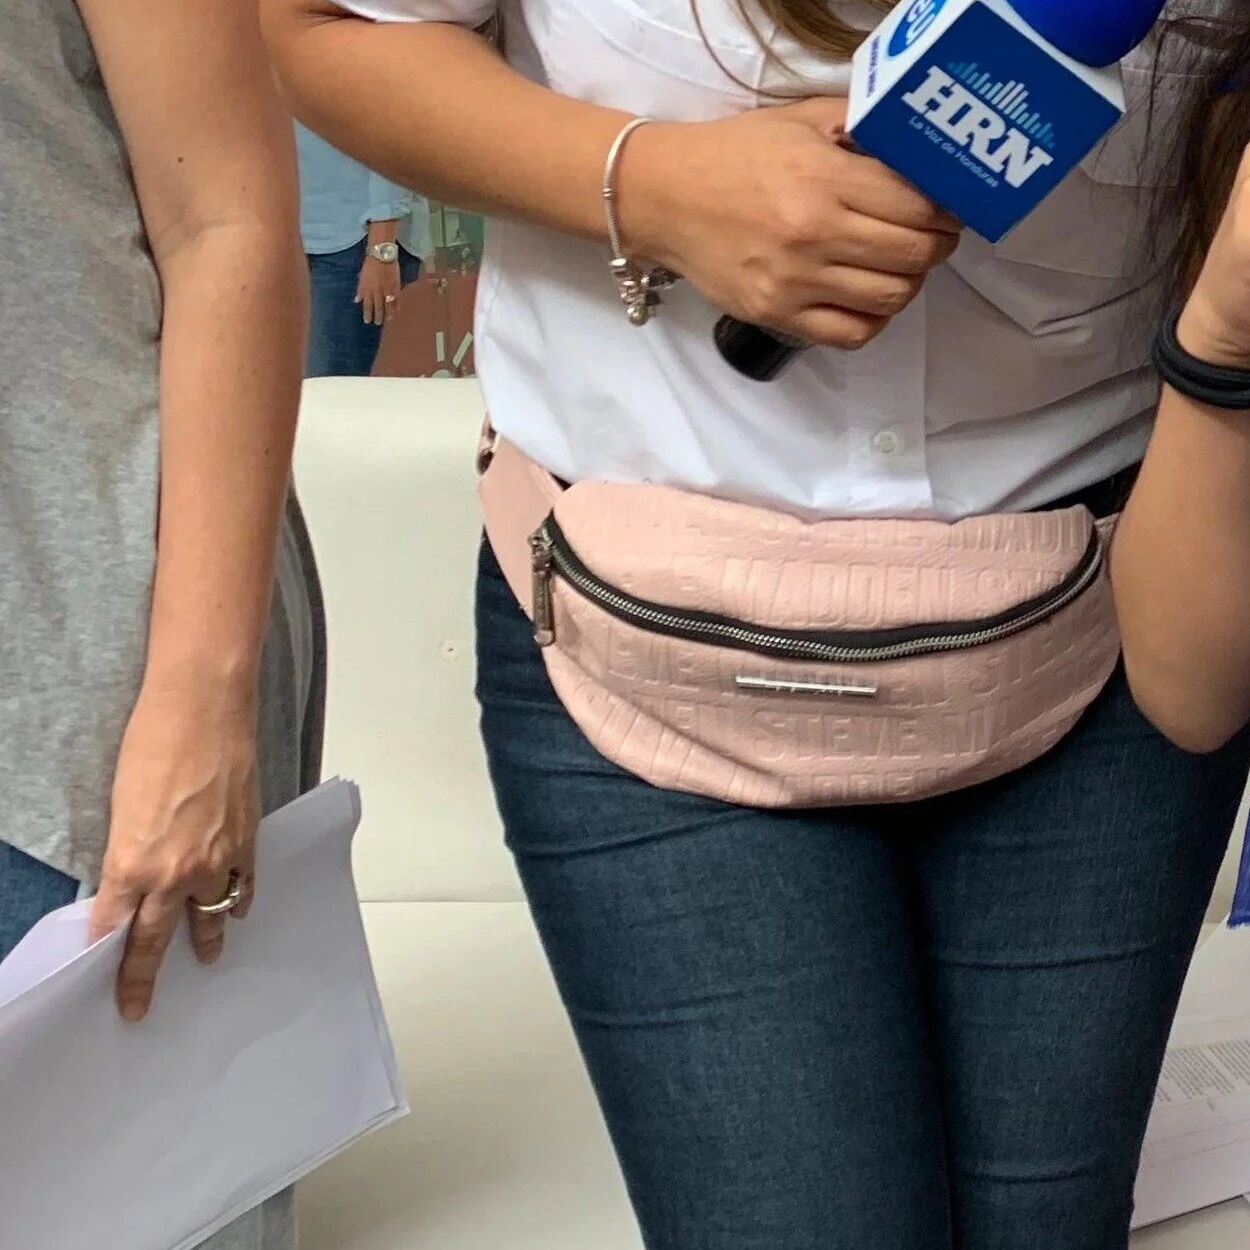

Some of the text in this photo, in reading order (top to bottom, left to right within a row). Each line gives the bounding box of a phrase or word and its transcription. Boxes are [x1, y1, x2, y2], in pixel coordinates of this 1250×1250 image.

[901, 65, 1054, 189] HRN
[908, 115, 925, 130] La
[923, 126, 944, 144] Voz
[954, 151, 1000, 188] Honduras
